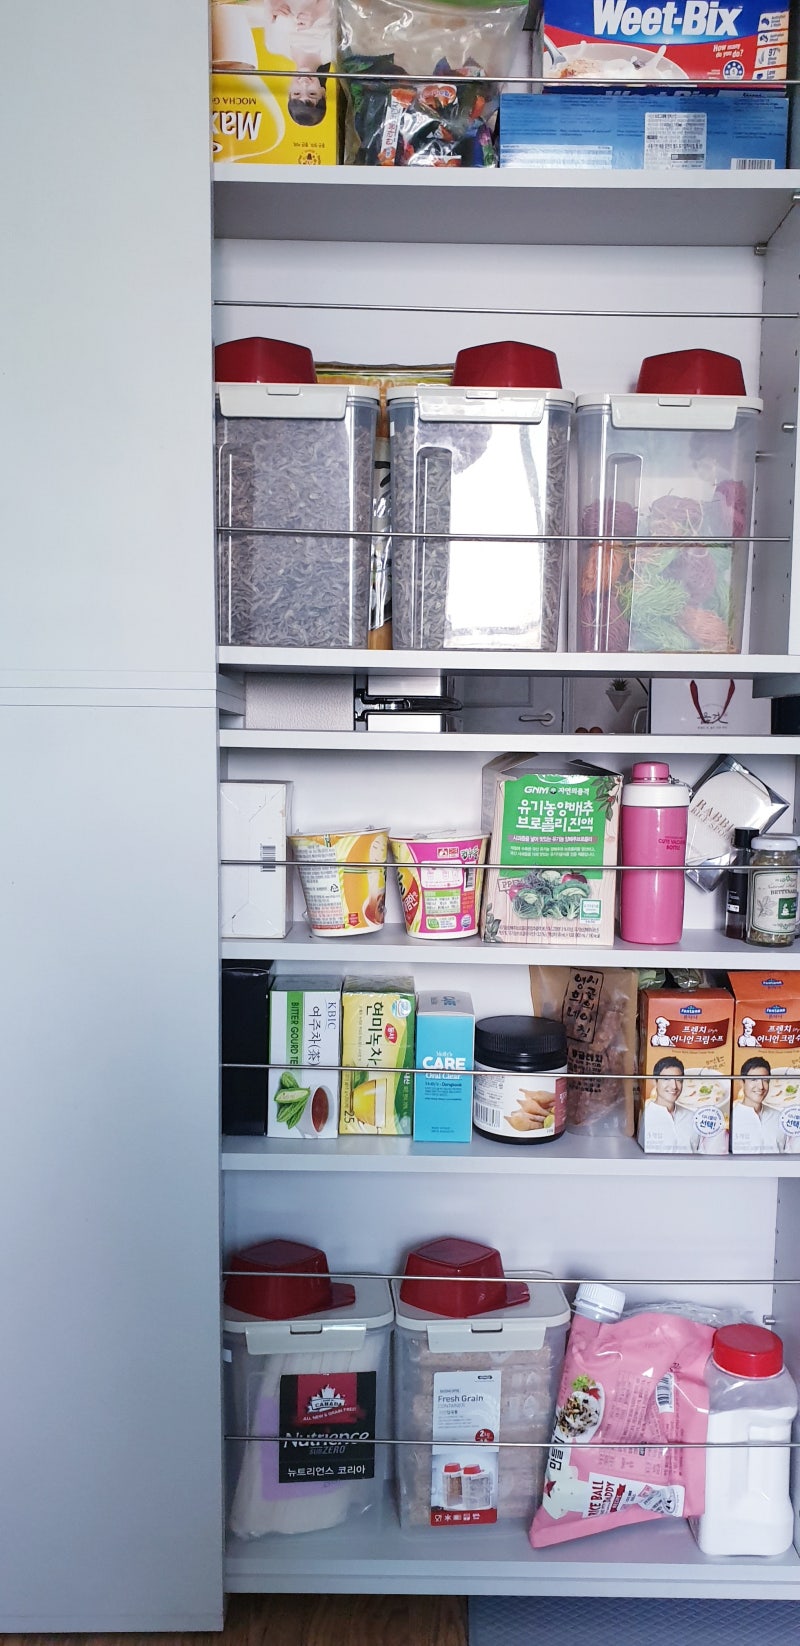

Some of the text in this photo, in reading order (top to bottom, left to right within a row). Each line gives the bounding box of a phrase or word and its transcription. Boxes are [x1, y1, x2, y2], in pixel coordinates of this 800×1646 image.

[593, 0, 744, 37] Weet-Bix
[713, 44, 727, 53] How
[223, 96, 257, 105] MOCHA
[327, 1002, 337, 1030] KBIC
[290, 1001, 300, 1066] BITTER GOURD TE
[365, 1001, 384, 1067] 현미녹차
[682, 1026, 707, 1035] 프렌치
[768, 1025, 792, 1034] 프렌치
[671, 1035, 694, 1044] 어니언
[694, 1035, 710, 1045] 크림
[422, 1056, 466, 1071] CARE
[343, 1110, 356, 1125] 25
[438, 1394, 484, 1403] Fresh Grain
[283, 1431, 370, 1449] Nutrience
[288, 1464, 366, 1477] 뉴트리언스 코리아
[591, 1479, 604, 1502] BALL
